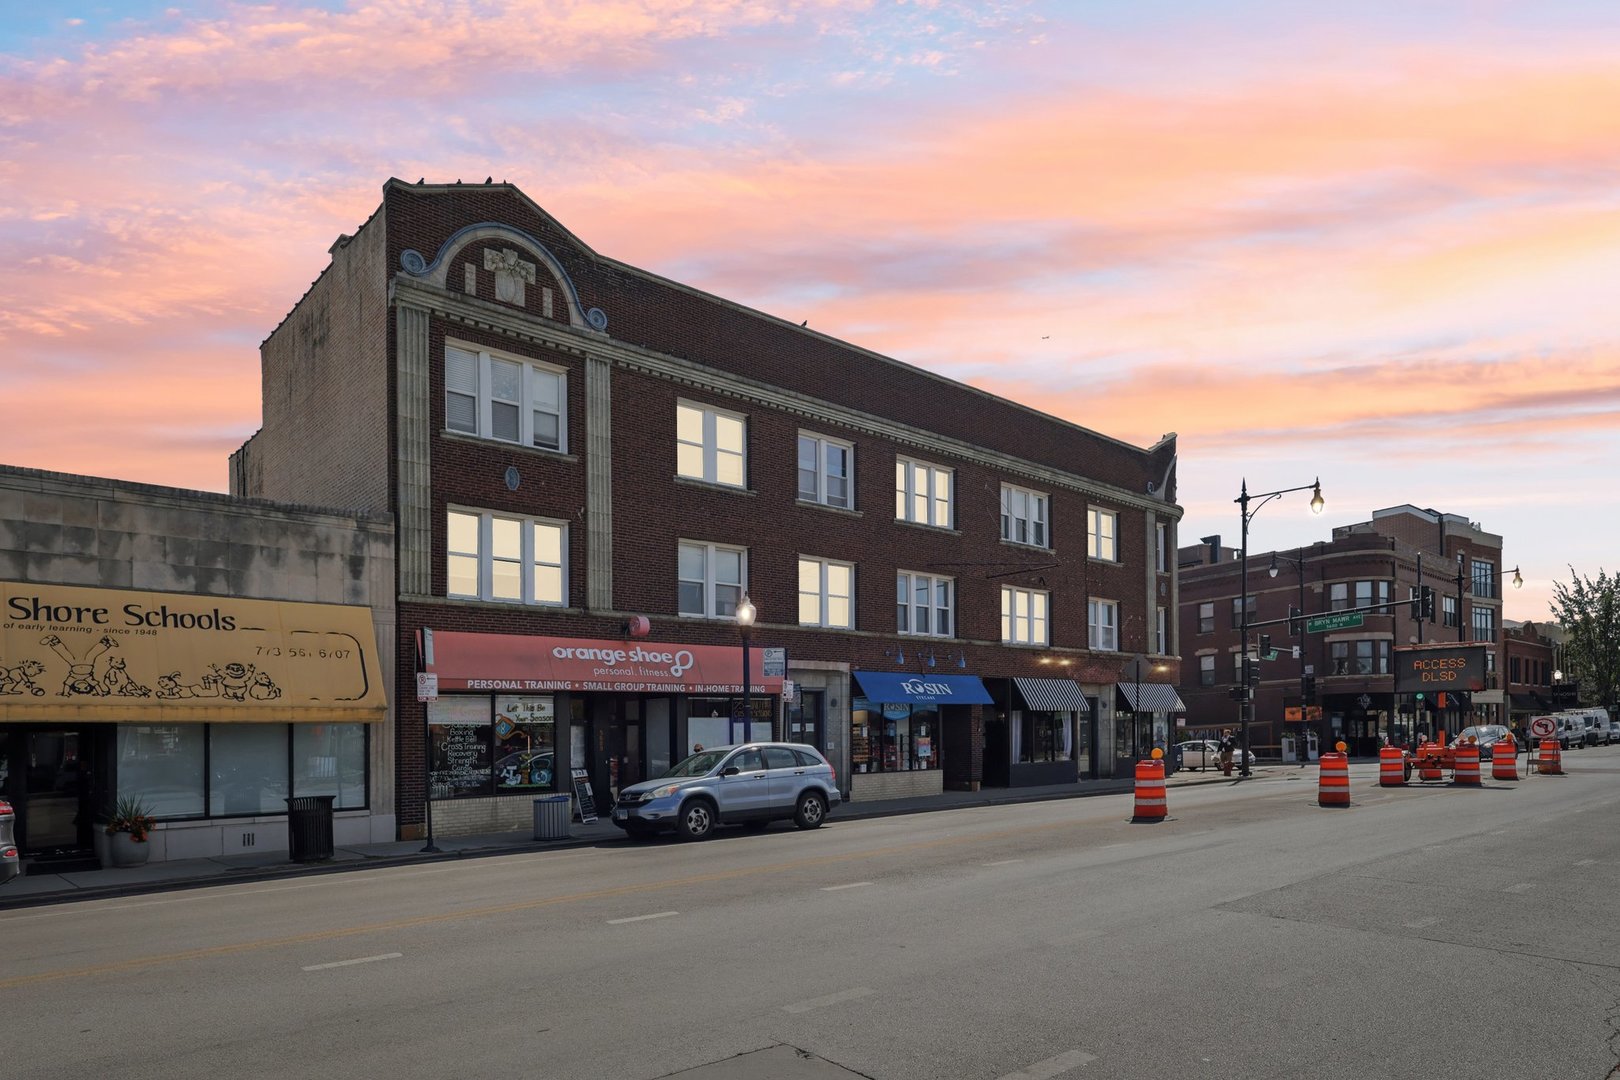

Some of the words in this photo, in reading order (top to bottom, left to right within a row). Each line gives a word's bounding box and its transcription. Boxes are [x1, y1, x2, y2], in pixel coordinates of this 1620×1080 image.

[8, 597, 109, 624] Shore
[123, 604, 236, 631] Schools
[1314, 619, 1331, 627] BRYN
[1332, 615, 1350, 624] MAWR
[18, 624, 46, 632] early
[49, 625, 92, 634] learning
[552, 646, 627, 666] orange
[628, 646, 673, 663] shoe
[1413, 657, 1466, 671] ACCESS
[1422, 671, 1457, 682] DLSD
[467, 680, 522, 689] PERSONAL
[524, 680, 572, 690] TRAINING
[583, 681, 612, 691] SMALL
[614, 682, 645, 692] GROUP
[646, 684, 686, 693] TRAINING
[695, 684, 730, 693] IN-HOME
[731, 685, 766, 694] TRAING
[900, 679, 953, 695] ROSIN
[506, 704, 519, 713] Let
[522, 703, 535, 713] This
[536, 704, 546, 712] Be
[883, 703, 910, 712] ROSIN
[449, 728, 474, 737] Boxing
[440, 742, 463, 751] Cross
[464, 742, 487, 753] Training
[447, 750, 478, 758] Recovery
[447, 757, 478, 766] Strength
